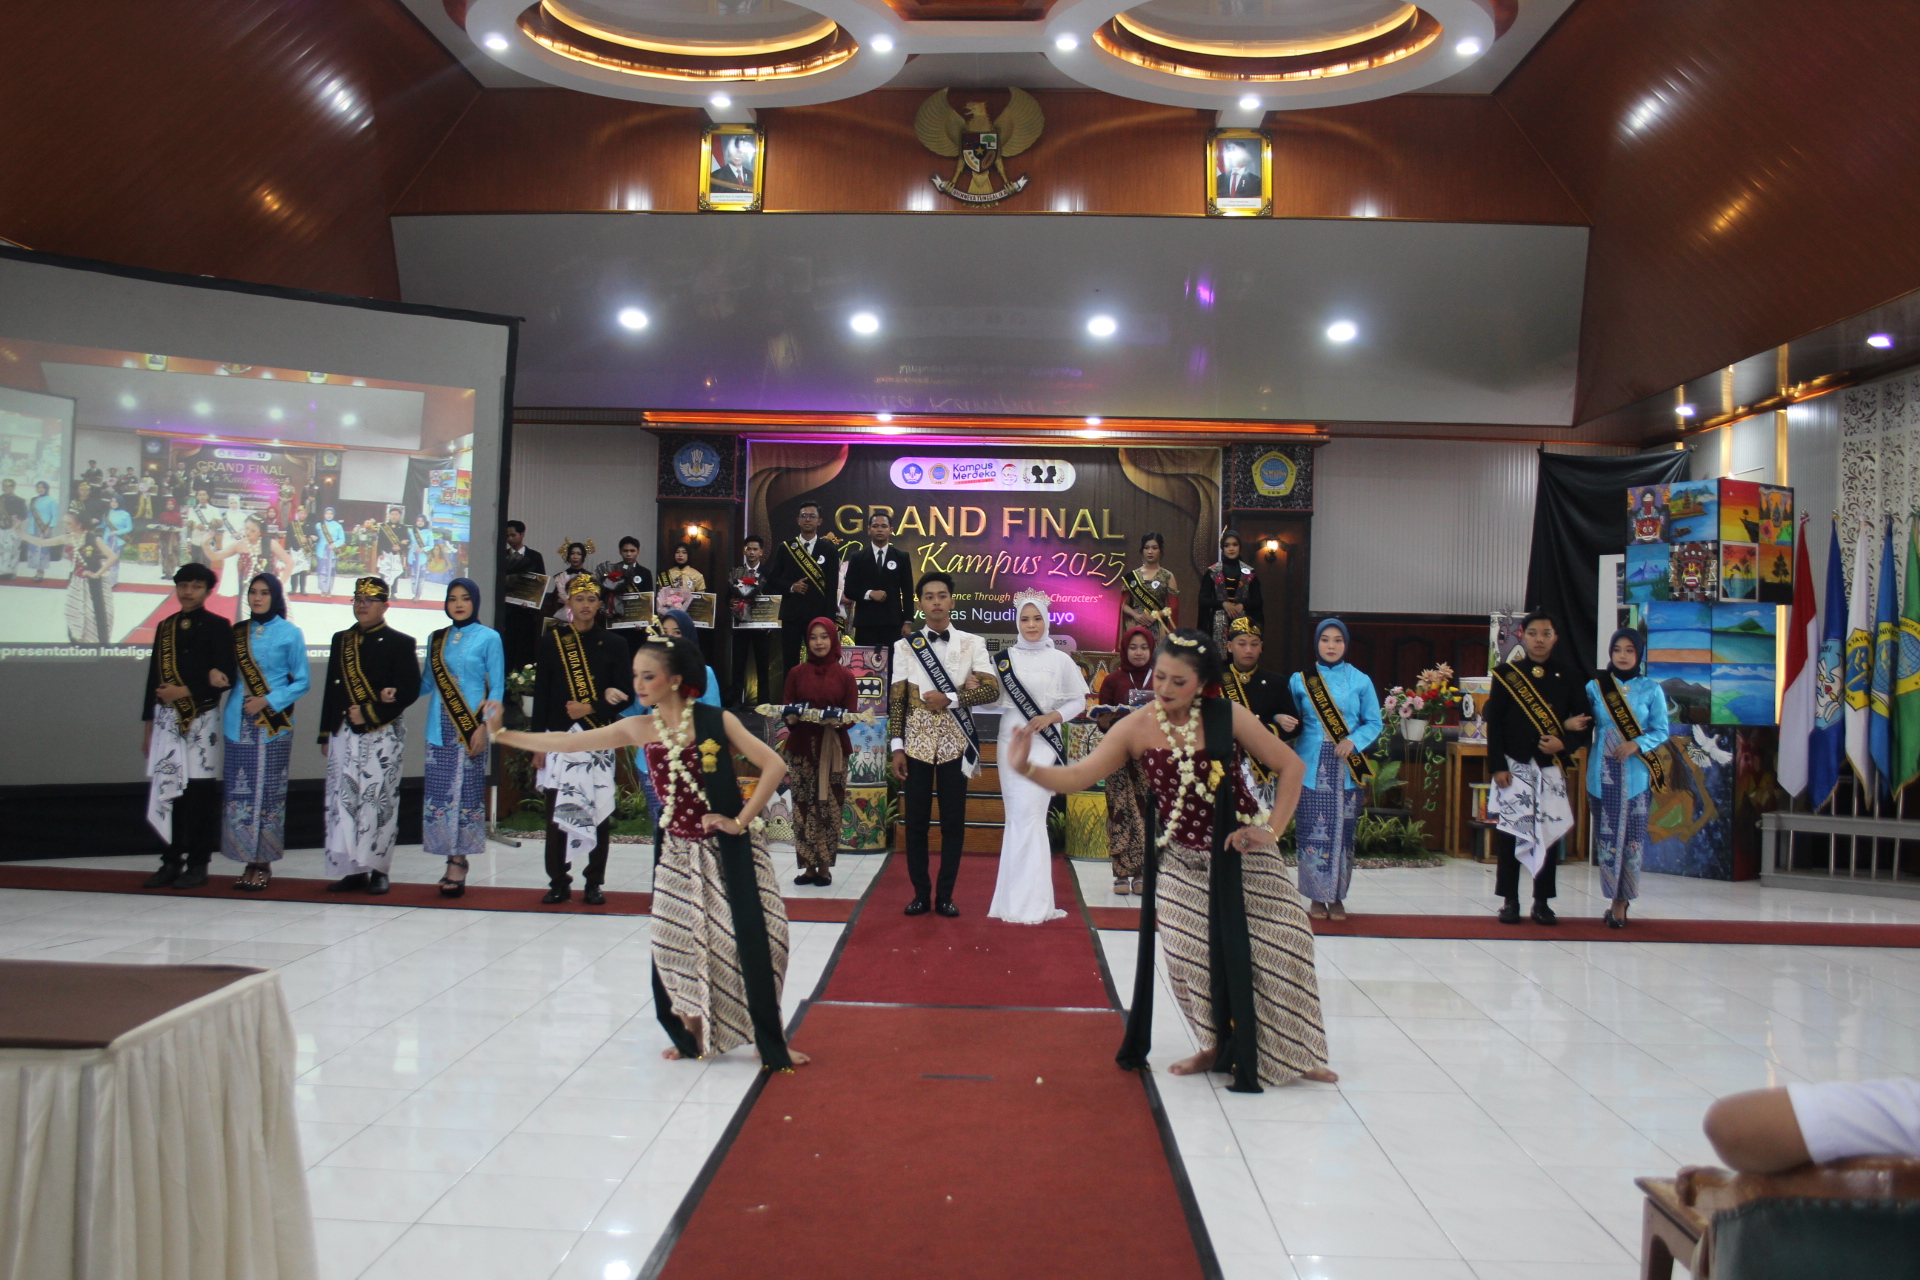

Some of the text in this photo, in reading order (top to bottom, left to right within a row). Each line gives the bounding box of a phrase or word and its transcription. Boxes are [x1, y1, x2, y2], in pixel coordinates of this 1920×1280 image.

[197, 460, 286, 476] GRAND FINAL
[952, 470, 997, 480] Merdeka
[953, 462, 994, 473] Kampus
[834, 504, 1125, 540] GRAND FINAL
[917, 541, 1042, 590] Kampus
[1047, 552, 1126, 587] 2025
[974, 592, 1011, 604] Through
[971, 607, 1016, 624] Ngudi
[101, 645, 153, 660] Intelige
[567, 650, 581, 669] DUTA
[919, 649, 935, 670] PUTRA
[931, 667, 944, 685] DUTA
[573, 669, 590, 697] KAMPUS
[1003, 672, 1013, 692] PUTRI
[1010, 687, 1027, 705] DUTA
[438, 673, 454, 700] KAMPUS
[449, 697, 464, 714] UNW
[458, 712, 473, 732] 2023
[1313, 691, 1326, 710] DUTA
[1323, 708, 1343, 734] KAMPUS
[1517, 686, 1534, 705] DUTA
[1530, 702, 1553, 728] KAMPUS
[1614, 706, 1630, 728] DUTA
